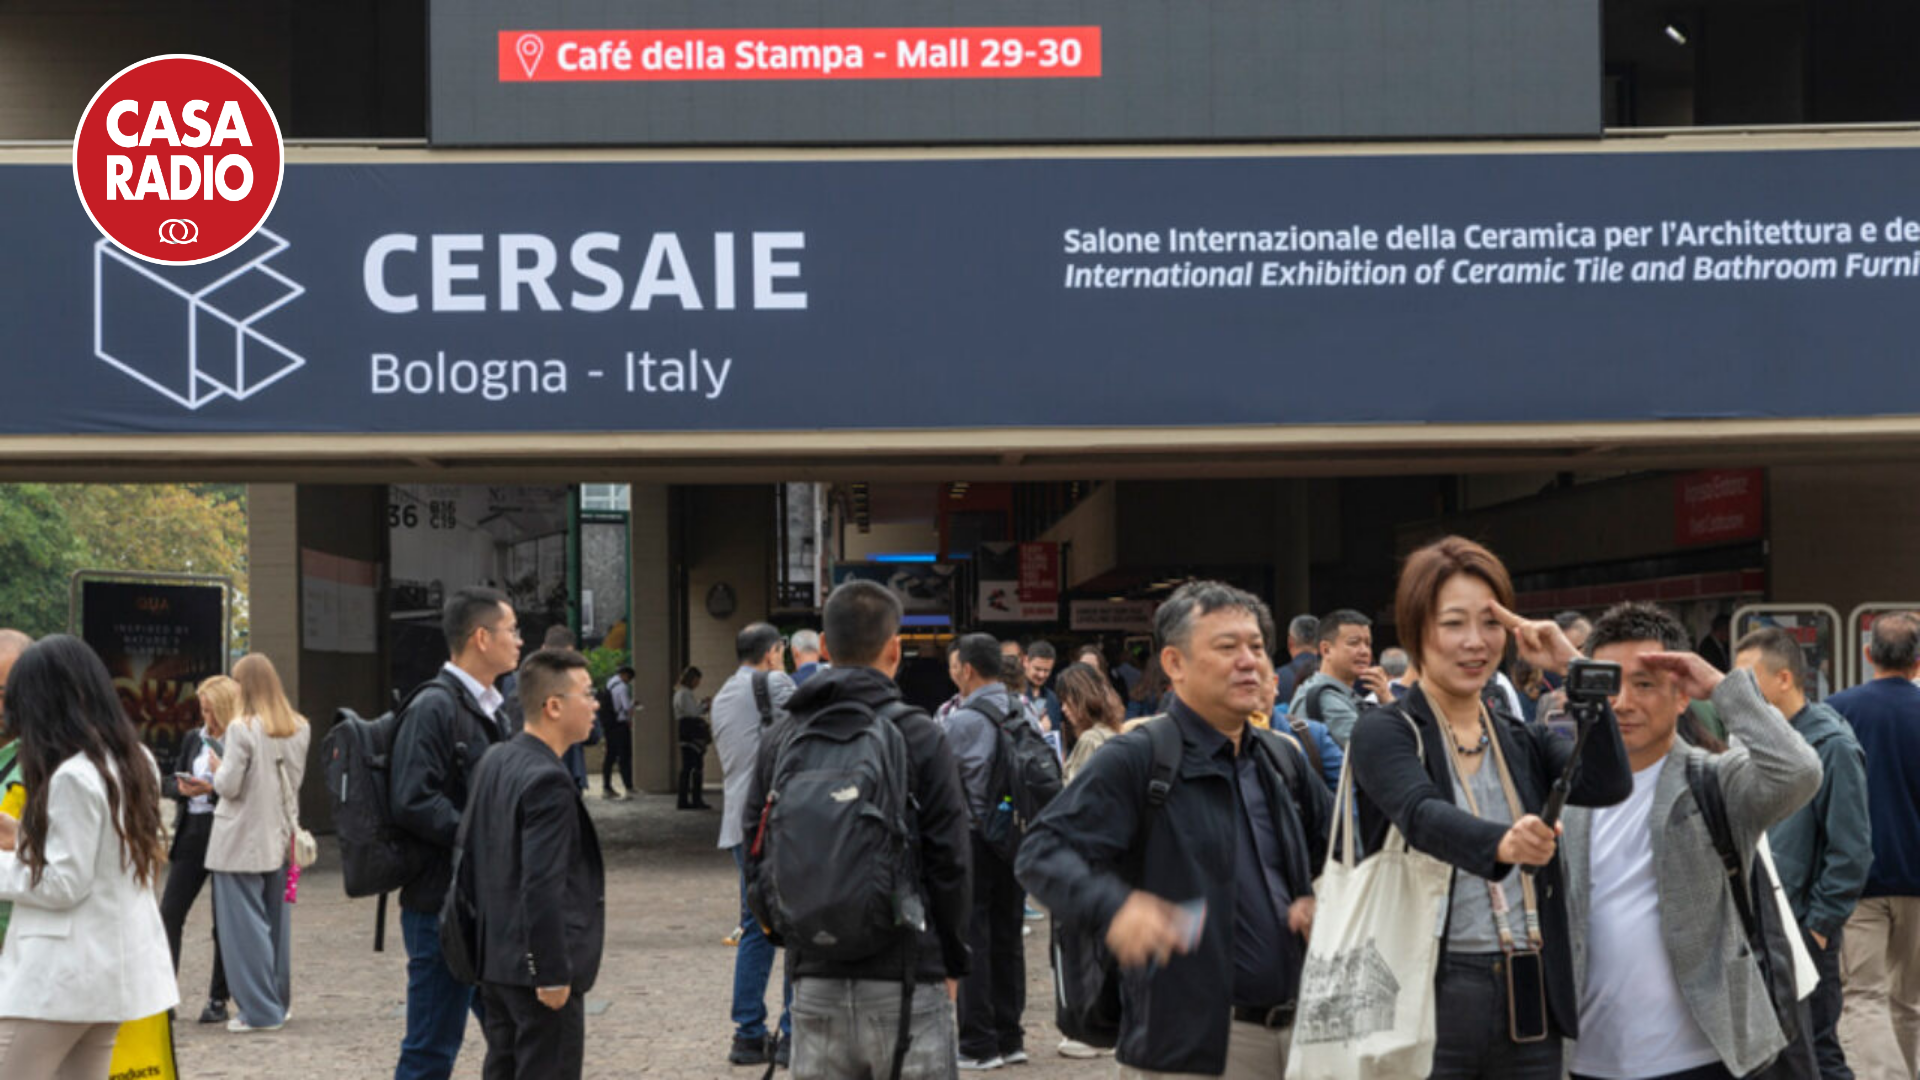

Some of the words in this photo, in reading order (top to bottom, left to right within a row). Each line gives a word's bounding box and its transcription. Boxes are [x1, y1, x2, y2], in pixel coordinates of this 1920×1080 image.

[557, 40, 632, 71] Café
[641, 40, 725, 70] della
[735, 40, 863, 74] Stampa
[897, 38, 969, 68] Mall
[980, 38, 1082, 68] 29-30
[1064, 228, 1161, 253] Salone
[1169, 225, 1378, 252] Internazionale
[1386, 224, 1456, 250] della
[1464, 222, 1596, 249] Ceramica
[1604, 226, 1653, 251] per
[1661, 219, 1852, 246] l'Architettura
[1860, 222, 1878, 242] e
[363, 231, 808, 313] CERSAIE
[1064, 261, 1253, 288] International
[1260, 260, 1406, 287] Exhibition
[1414, 257, 1446, 284] of
[1451, 257, 1566, 284] Ceramic
[1573, 256, 1624, 283] Tile
[1630, 256, 1686, 282] and
[1693, 255, 1837, 281] Bathroom
[371, 351, 567, 401] Bologna
[626, 349, 732, 399] Italy
